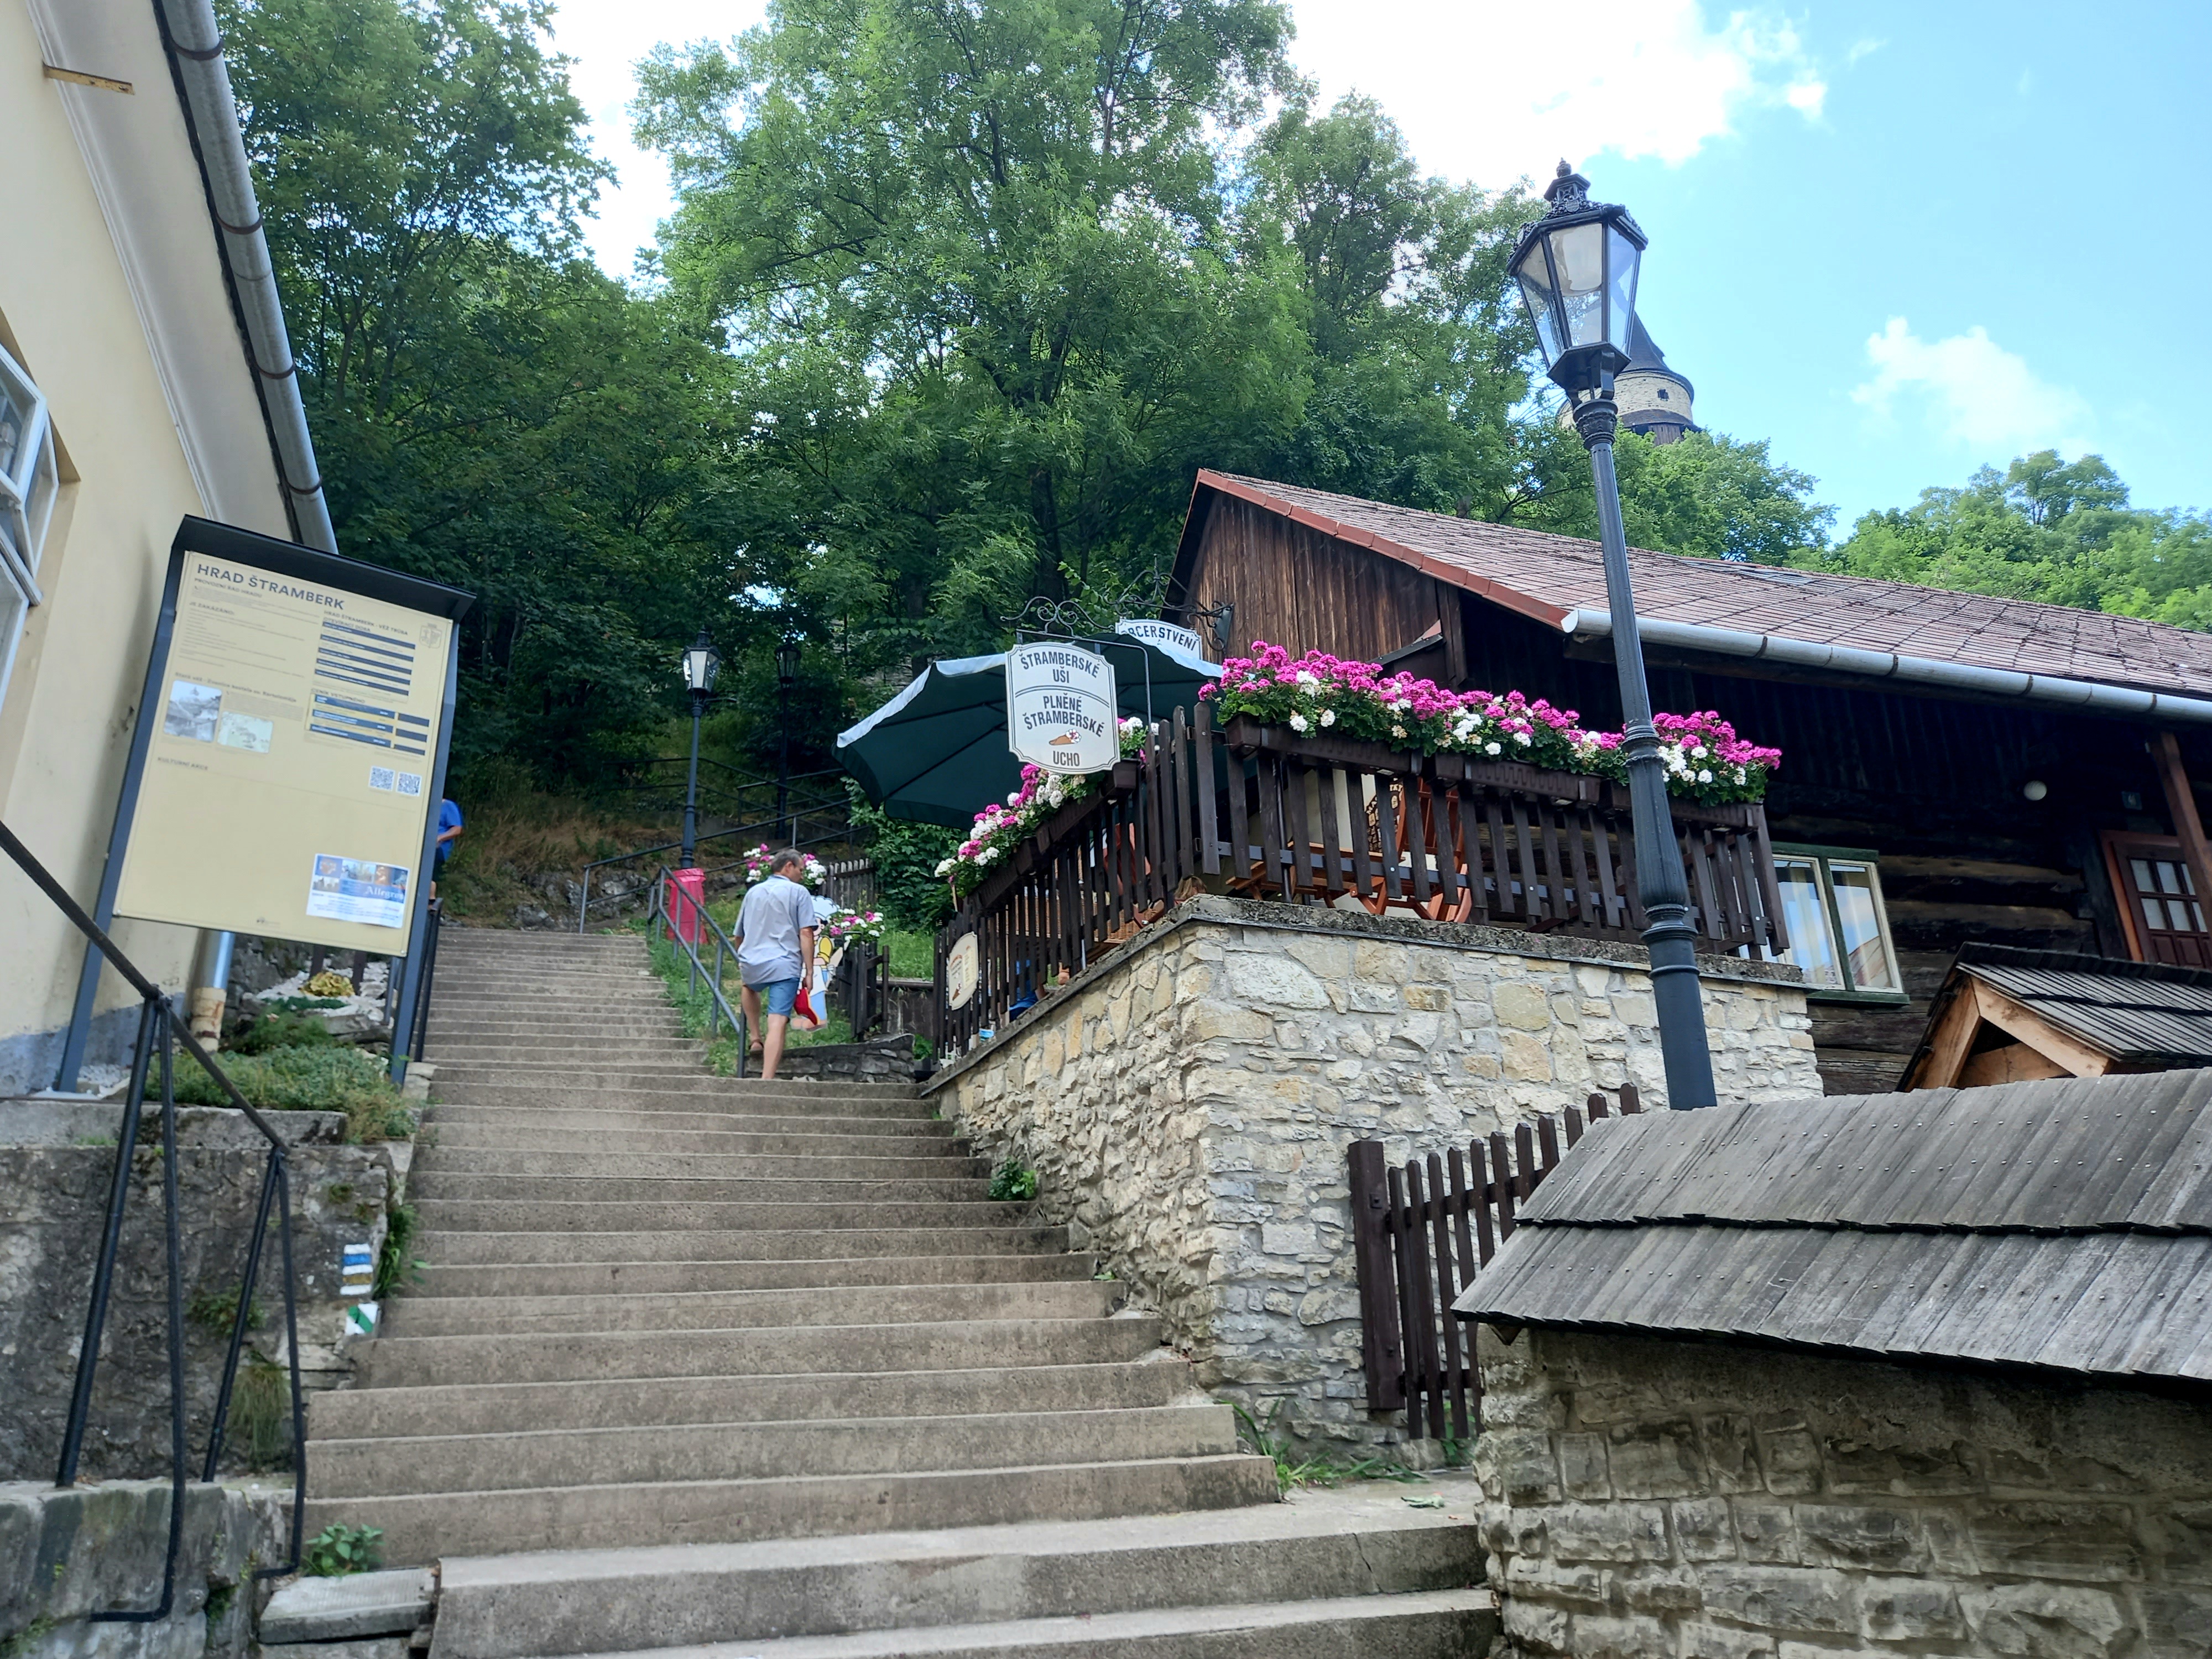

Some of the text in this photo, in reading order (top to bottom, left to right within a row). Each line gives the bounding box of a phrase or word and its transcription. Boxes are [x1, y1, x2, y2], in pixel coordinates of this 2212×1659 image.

[197, 564, 244, 583] HRAD
[248, 574, 345, 610] ŠTRAMBERK
[1121, 625, 1200, 651] BCERSTVENÍ
[1019, 651, 1100, 679] ŠTRAMBERSKÉ
[1052, 666, 1070, 684] UŠI
[1043, 693, 1082, 713] PLNĚNÉ
[1022, 710, 1105, 738] ŠTRAMBERSKÉ
[1053, 750, 1080, 766] UCHO
